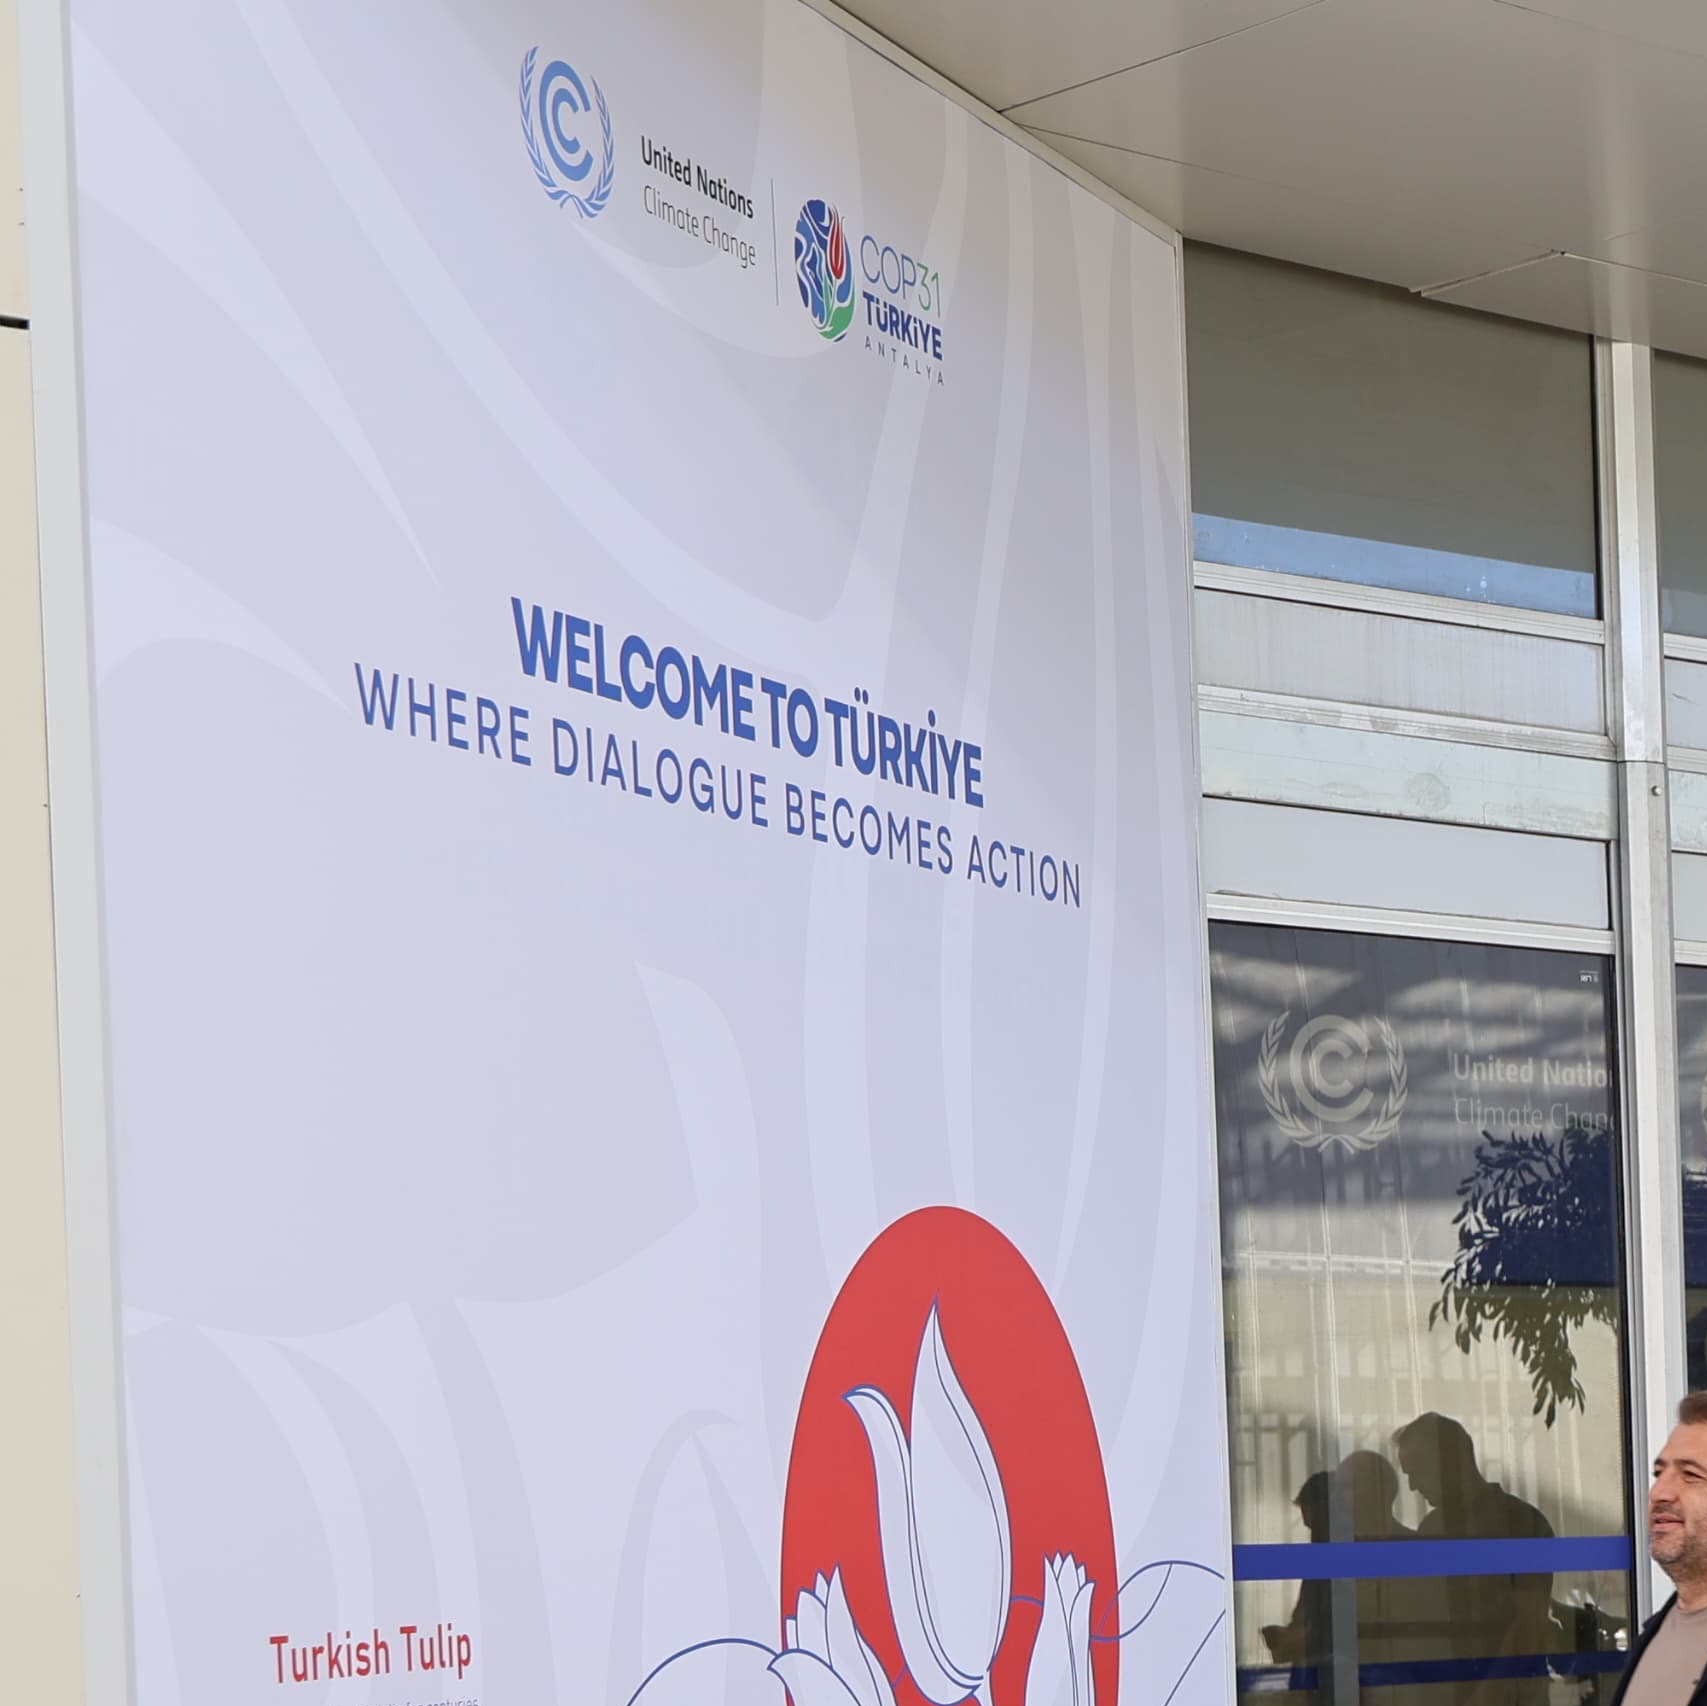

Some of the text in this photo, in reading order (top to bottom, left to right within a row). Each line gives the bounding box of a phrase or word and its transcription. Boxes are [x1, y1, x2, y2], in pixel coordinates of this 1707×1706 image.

[641, 135, 754, 219] United Nations
[644, 185, 756, 269] Climate Change
[860, 234, 941, 318] COP31
[864, 335, 944, 386] ANTALYA
[510, 596, 985, 808] WELCOME TO TÜRKİYE
[354, 662, 1081, 908] WHERE DIALOGUE BECOMES ACTION
[1453, 1052, 1613, 1088] United Natio
[1453, 1097, 1615, 1130] Climate Chan
[269, 1622, 472, 1684] Turkish Tulip
